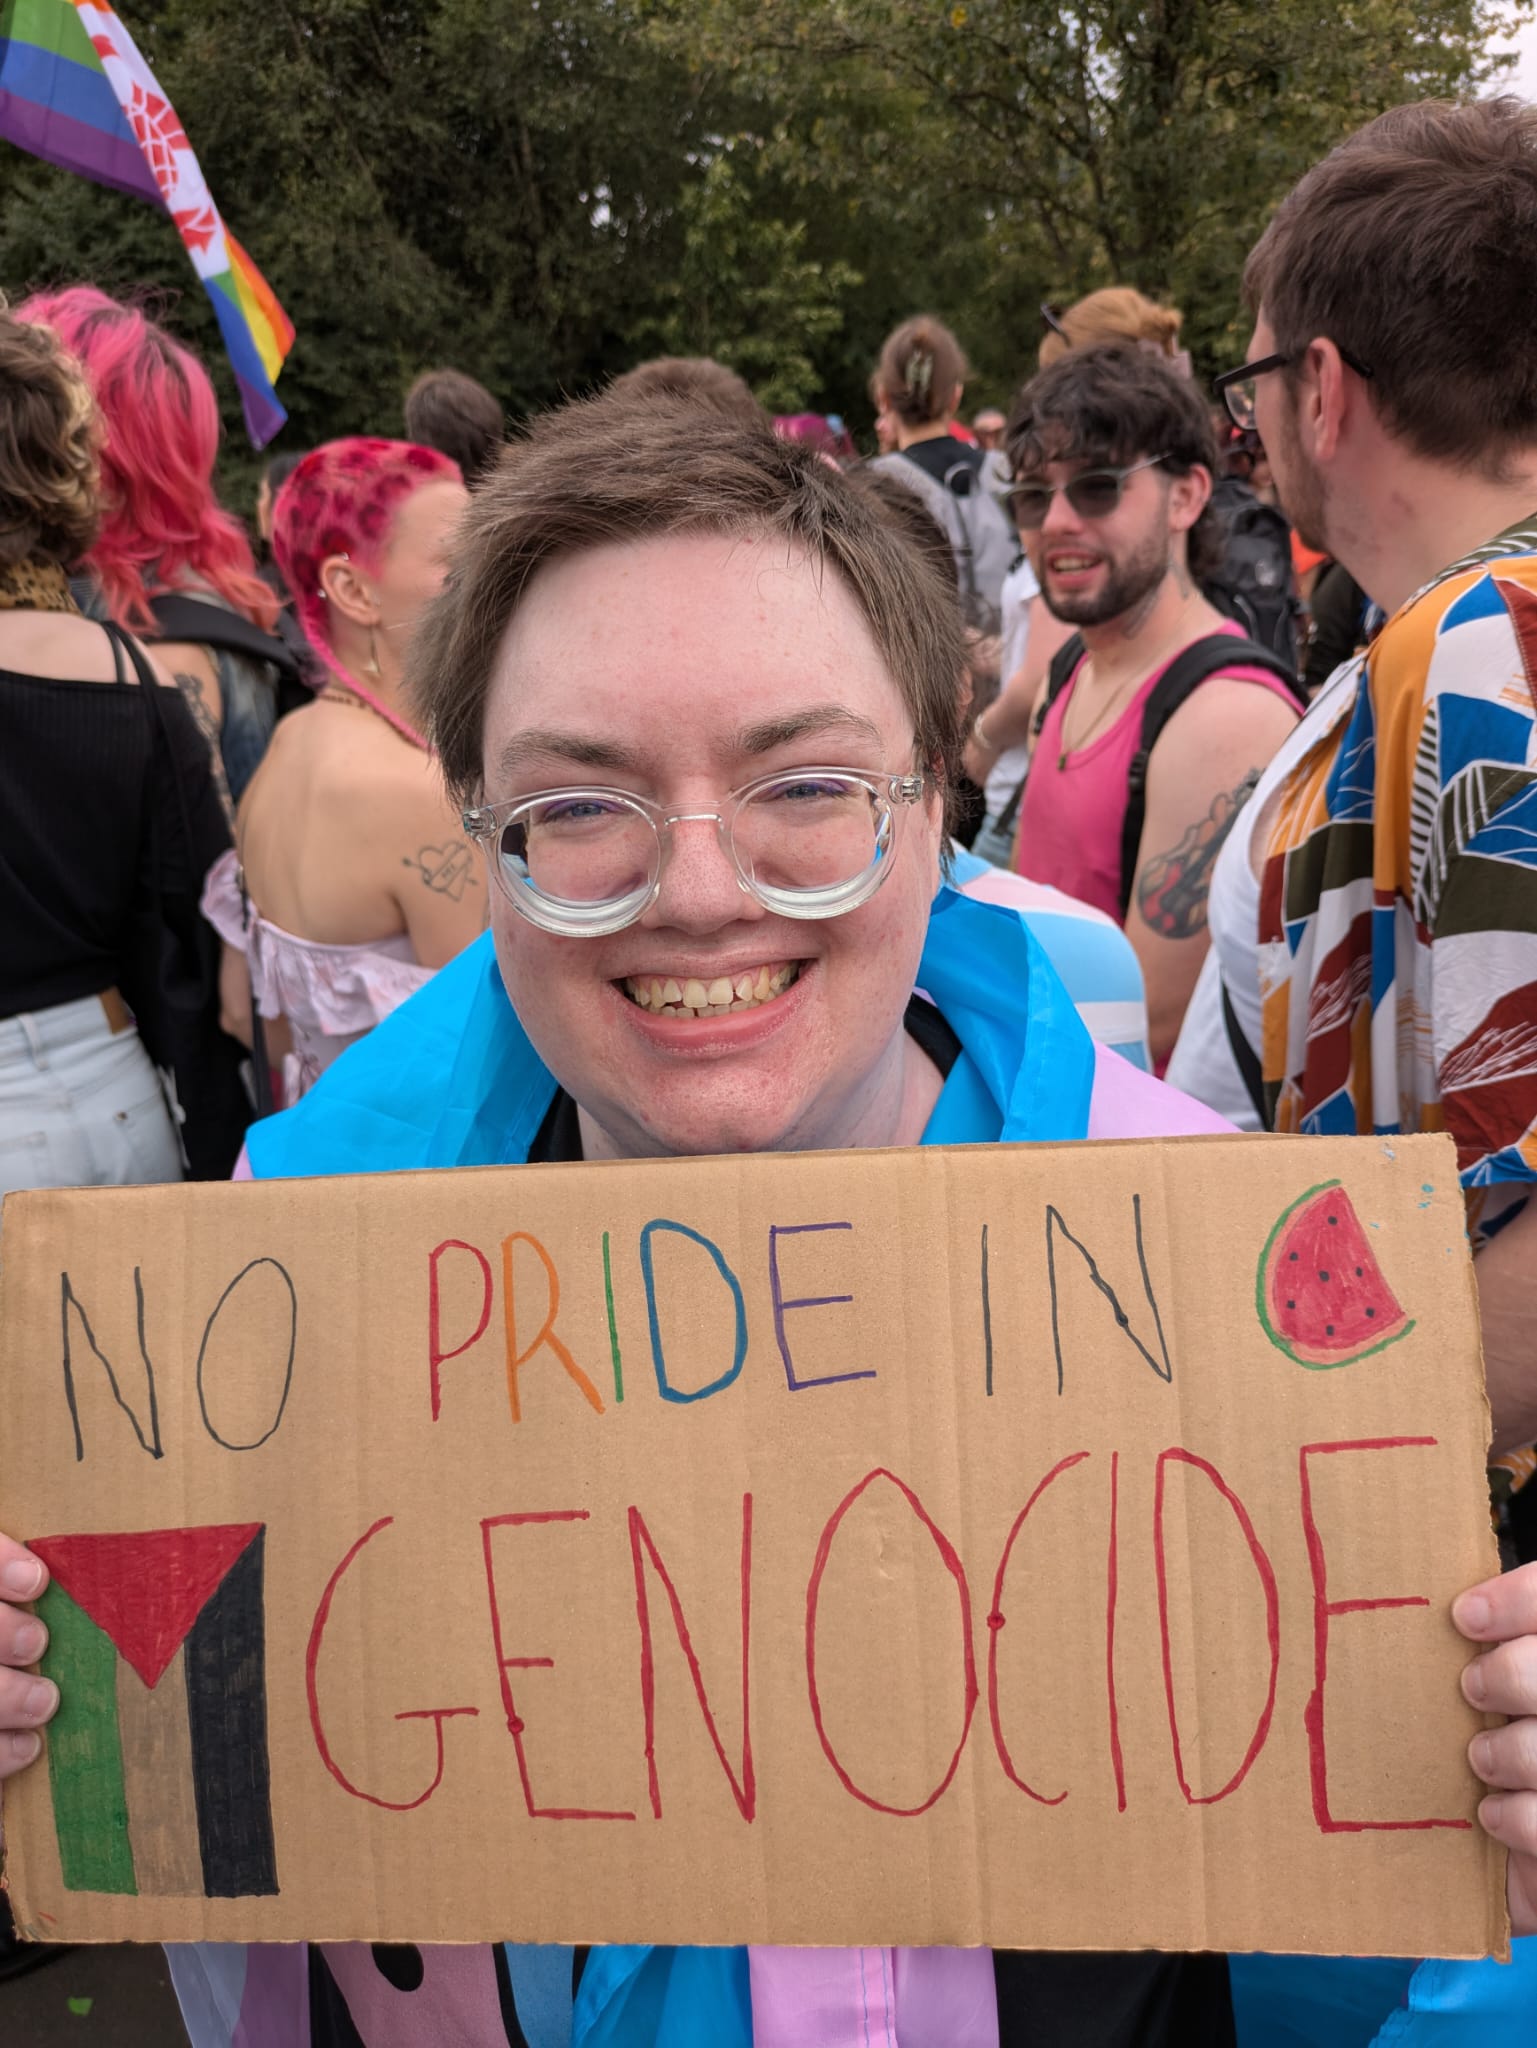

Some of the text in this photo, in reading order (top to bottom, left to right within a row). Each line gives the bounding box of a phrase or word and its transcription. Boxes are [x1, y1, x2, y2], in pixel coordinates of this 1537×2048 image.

[62, 1194, 1172, 1461] NO PRIDE IN
[306, 1436, 1472, 1832] GENOCIDE
